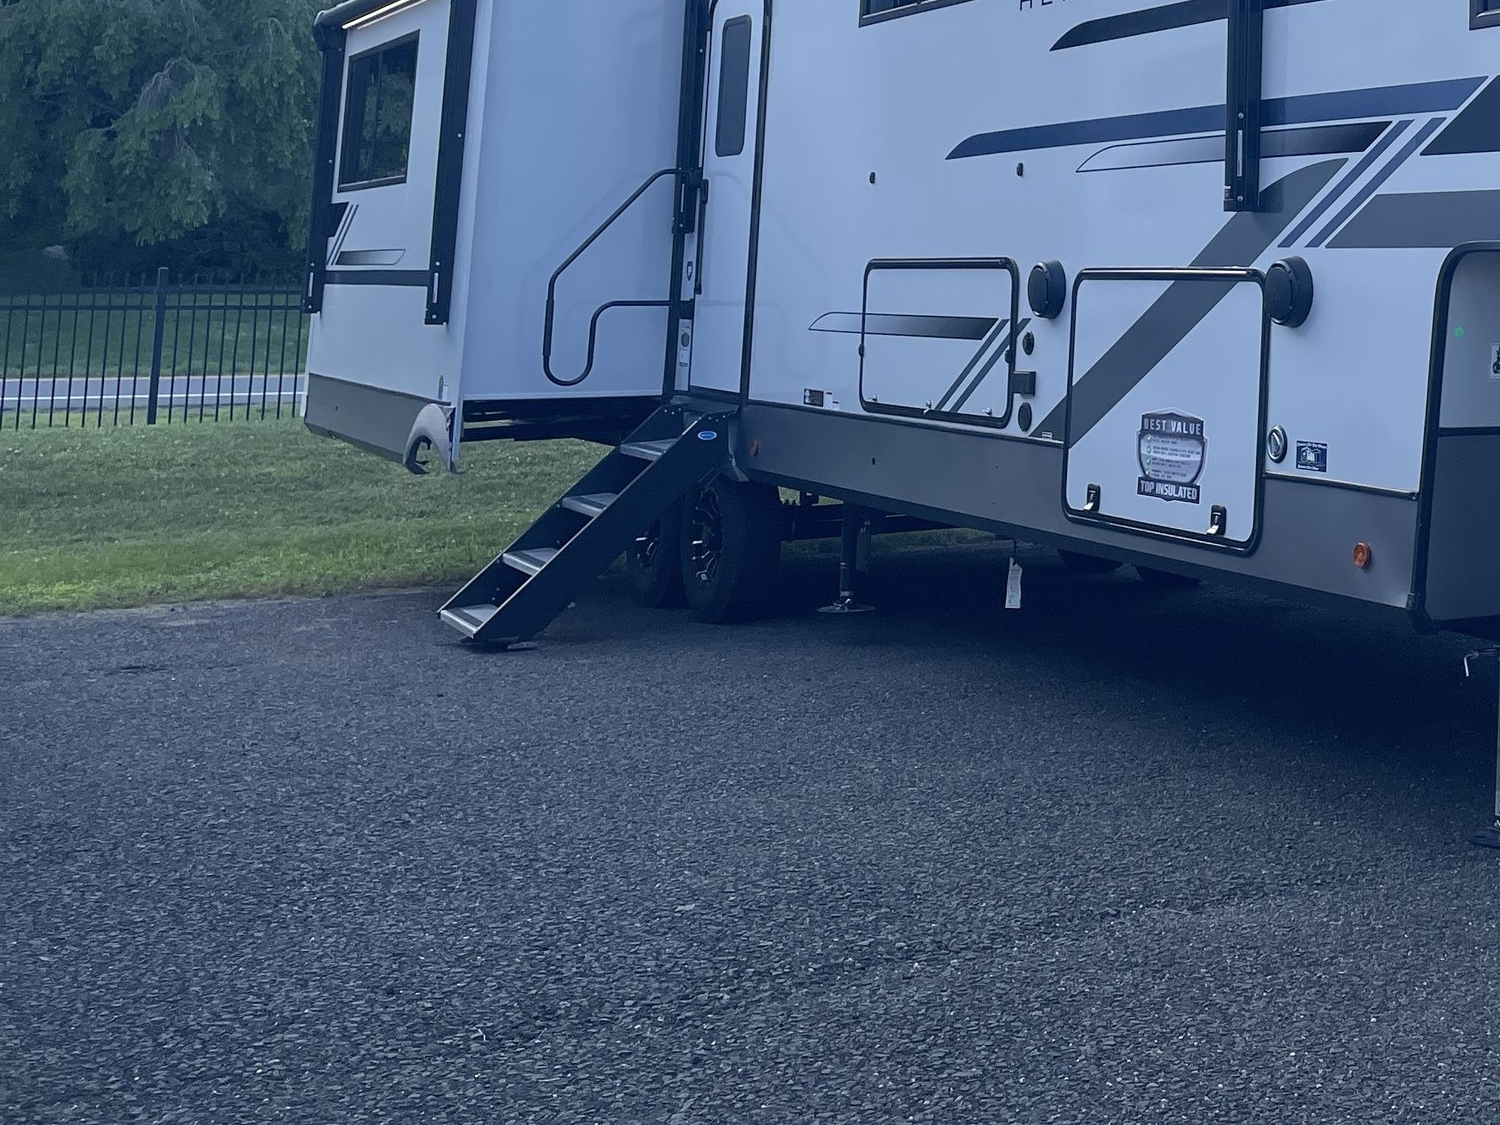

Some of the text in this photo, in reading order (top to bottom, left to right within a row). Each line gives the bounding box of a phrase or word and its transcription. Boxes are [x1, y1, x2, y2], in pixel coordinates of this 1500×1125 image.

[1170, 420, 1202, 435] VALUE
[1140, 480, 1198, 501] TOP INSULATED
